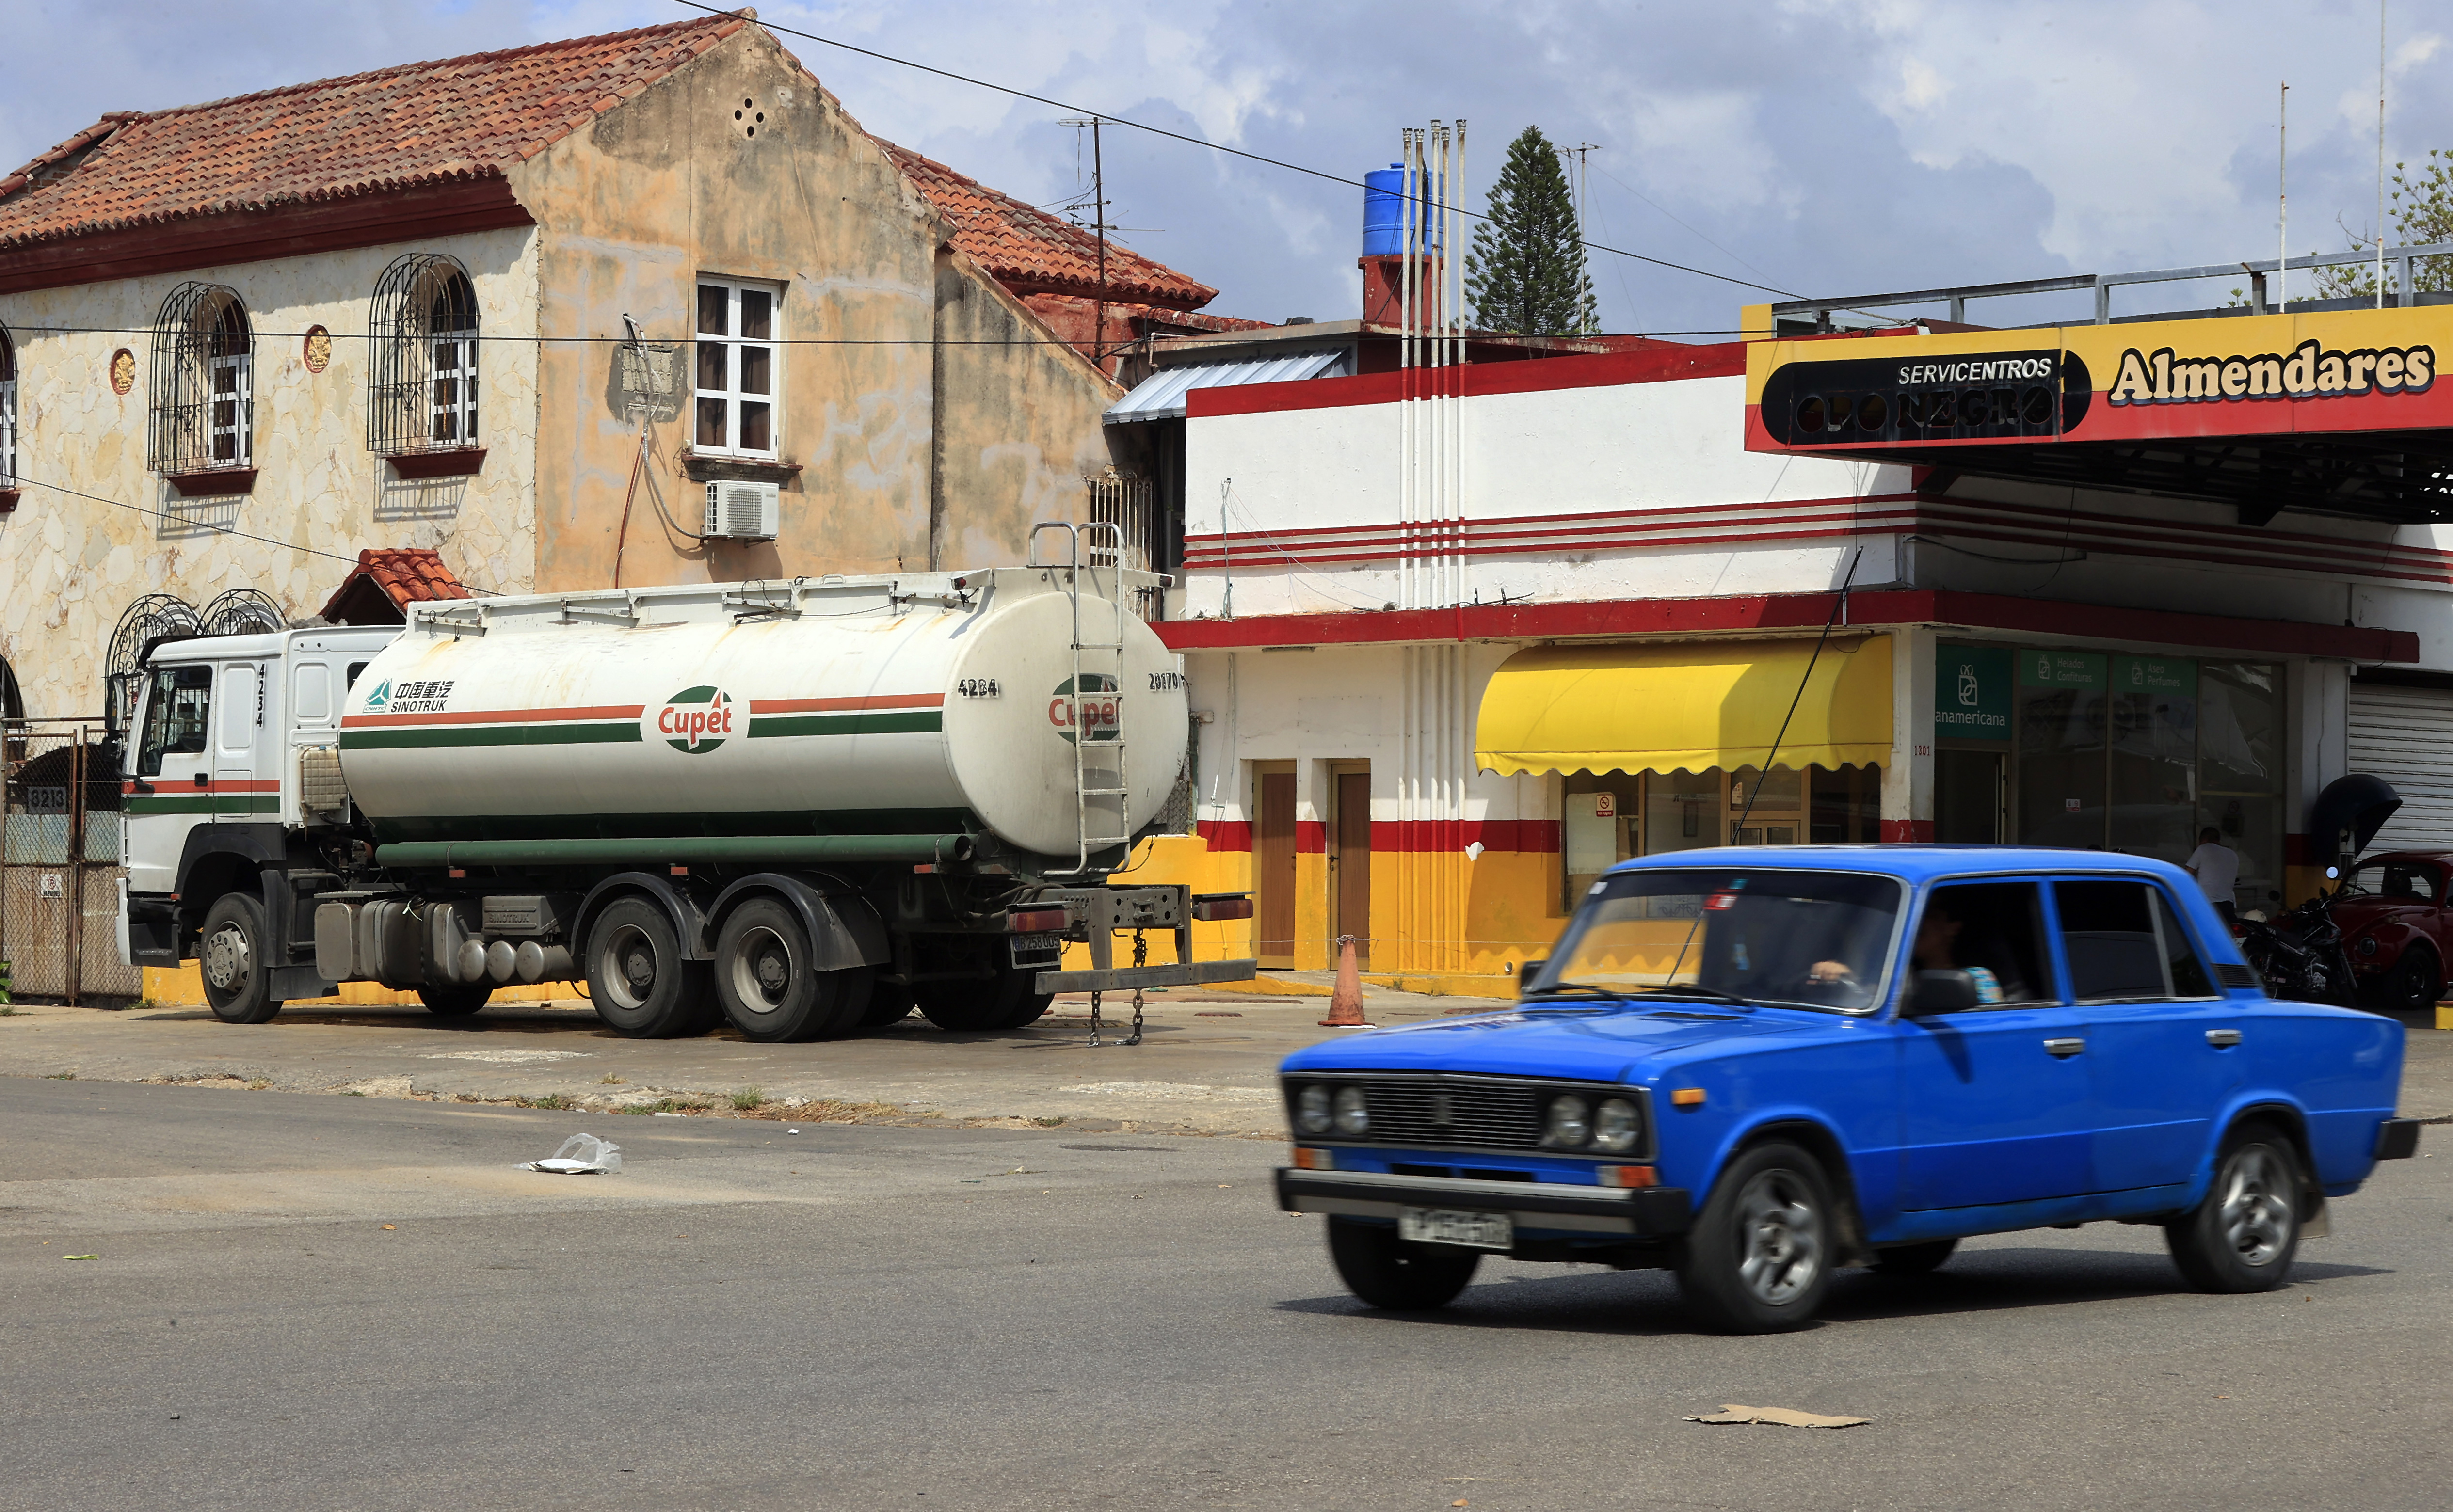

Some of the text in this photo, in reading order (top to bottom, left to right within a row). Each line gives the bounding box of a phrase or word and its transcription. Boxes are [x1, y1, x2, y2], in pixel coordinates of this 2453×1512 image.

[1898, 358, 2052, 385] SERVICENTROS
[2109, 340, 2434, 404] Almendares
[2058, 658, 2084, 668] Helados
[2148, 663, 2164, 673] Aseo
[1148, 672, 1178, 690] 20170
[2057, 671, 2092, 682] Confituras
[2148, 675, 2180, 687] Perfumes
[257, 664, 265, 728] 4234
[394, 681, 455, 699] 中国重汽
[391, 700, 447, 713] SINOTRUK
[658, 706, 732, 745] Cupet
[1935, 710, 2005, 726] anamericana
[1915, 746, 1930, 756] 1301
